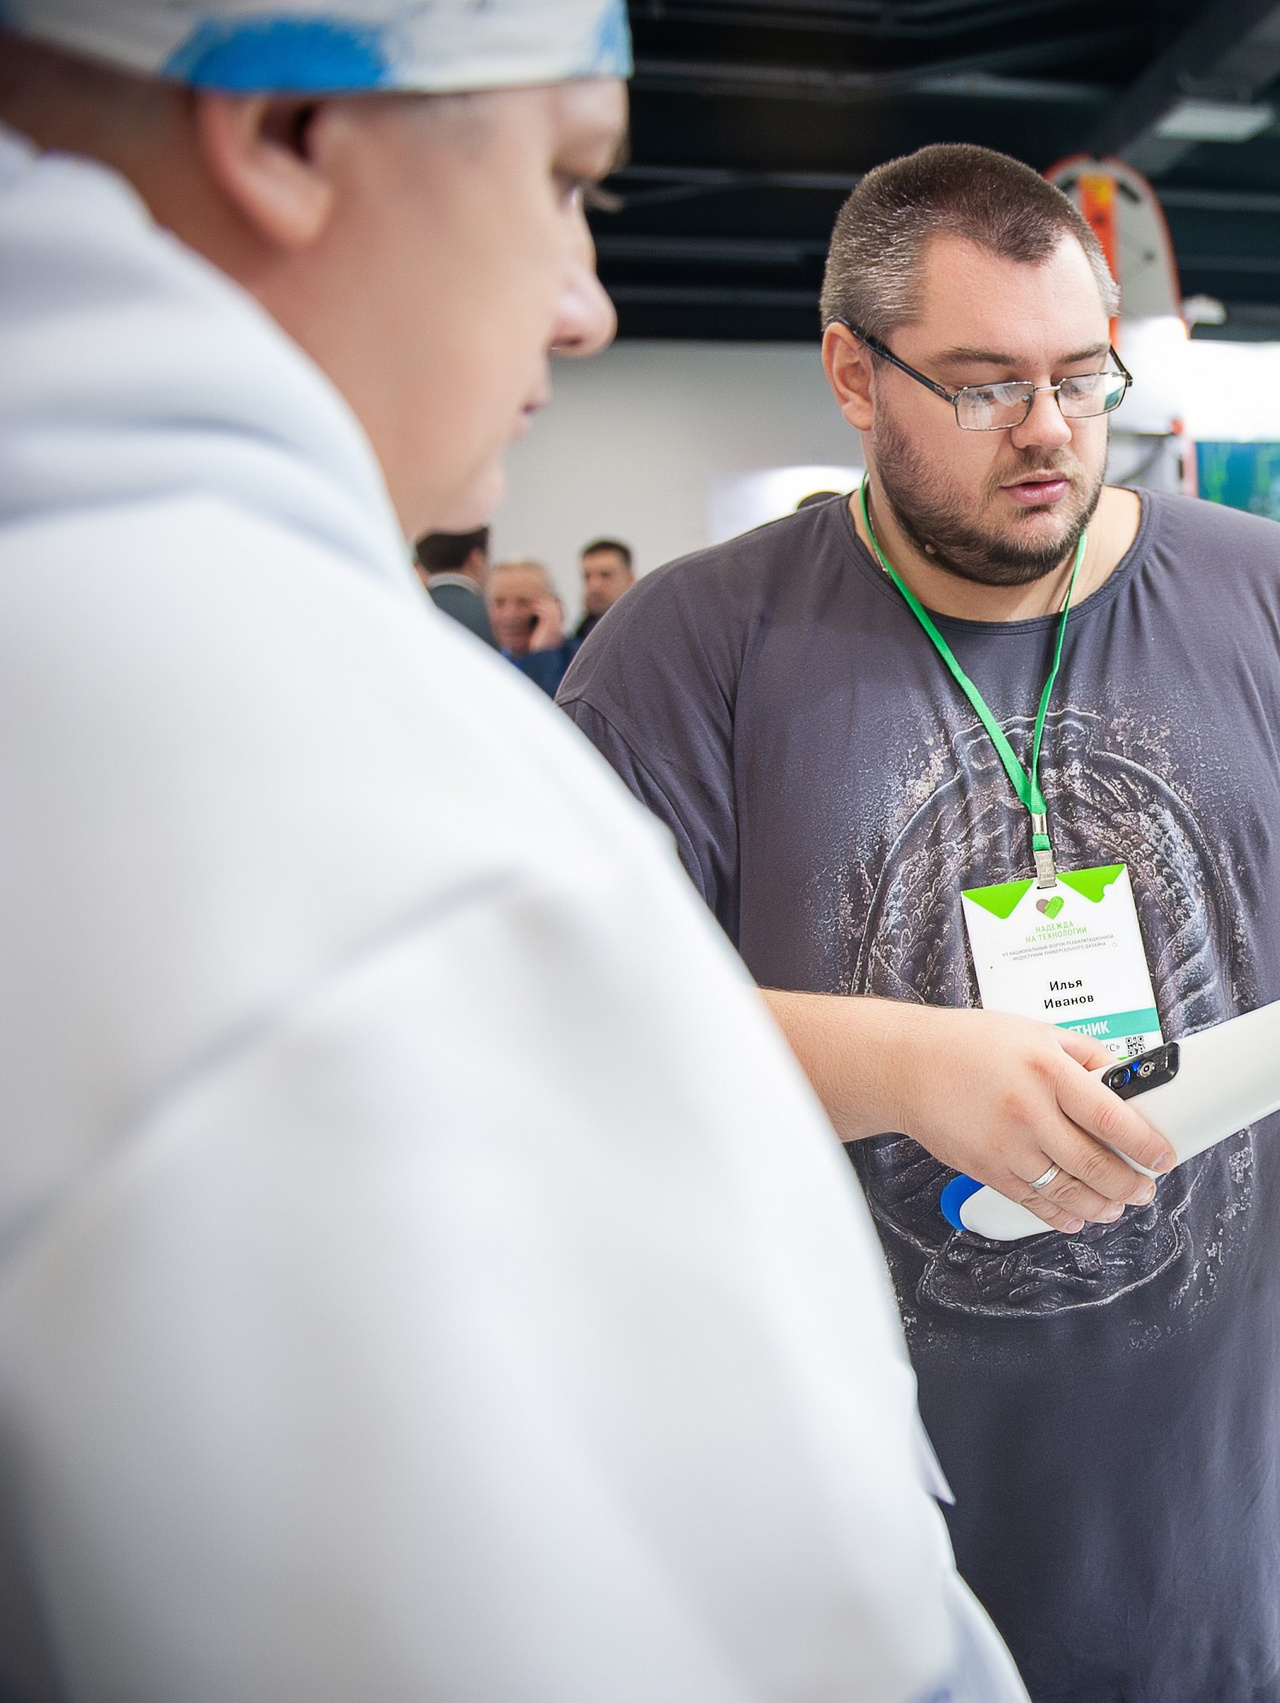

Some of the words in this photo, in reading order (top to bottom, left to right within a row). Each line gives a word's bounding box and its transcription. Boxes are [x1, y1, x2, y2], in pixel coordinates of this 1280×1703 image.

[1035, 921, 1074, 933] НАДЕЖДА
[1025, 935, 1036, 943] НА
[1038, 926, 1088, 941] ТЕХНОЛОГИИ
[1049, 979, 1083, 991] Илья
[1043, 994, 1094, 1009] Иванов
